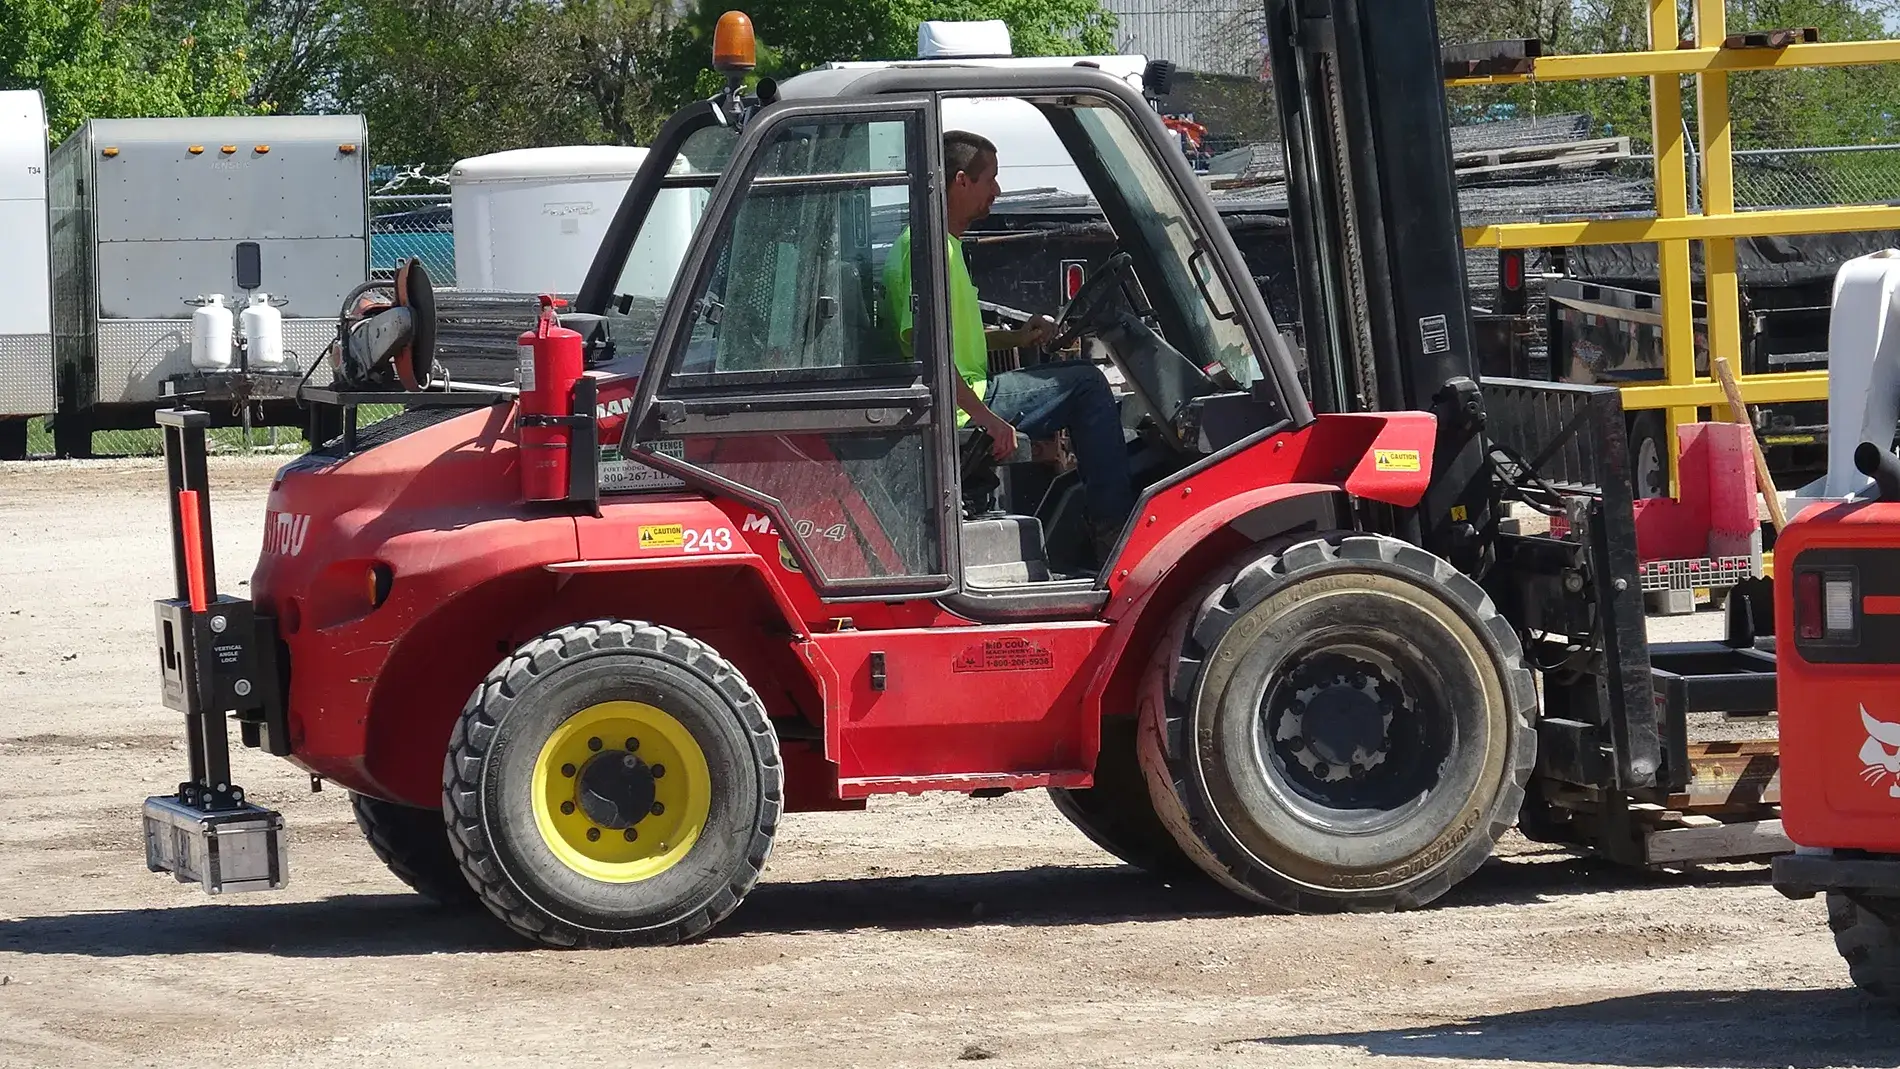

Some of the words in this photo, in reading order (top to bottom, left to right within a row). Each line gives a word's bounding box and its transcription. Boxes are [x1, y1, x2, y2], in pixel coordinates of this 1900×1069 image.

[27, 166, 41, 175] T34
[660, 440, 683, 452] FENCE
[1390, 453, 1418, 461] CAUTION
[653, 527, 681, 535] CAUTION
[682, 527, 733, 552] 243
[986, 641, 1002, 649] MID
